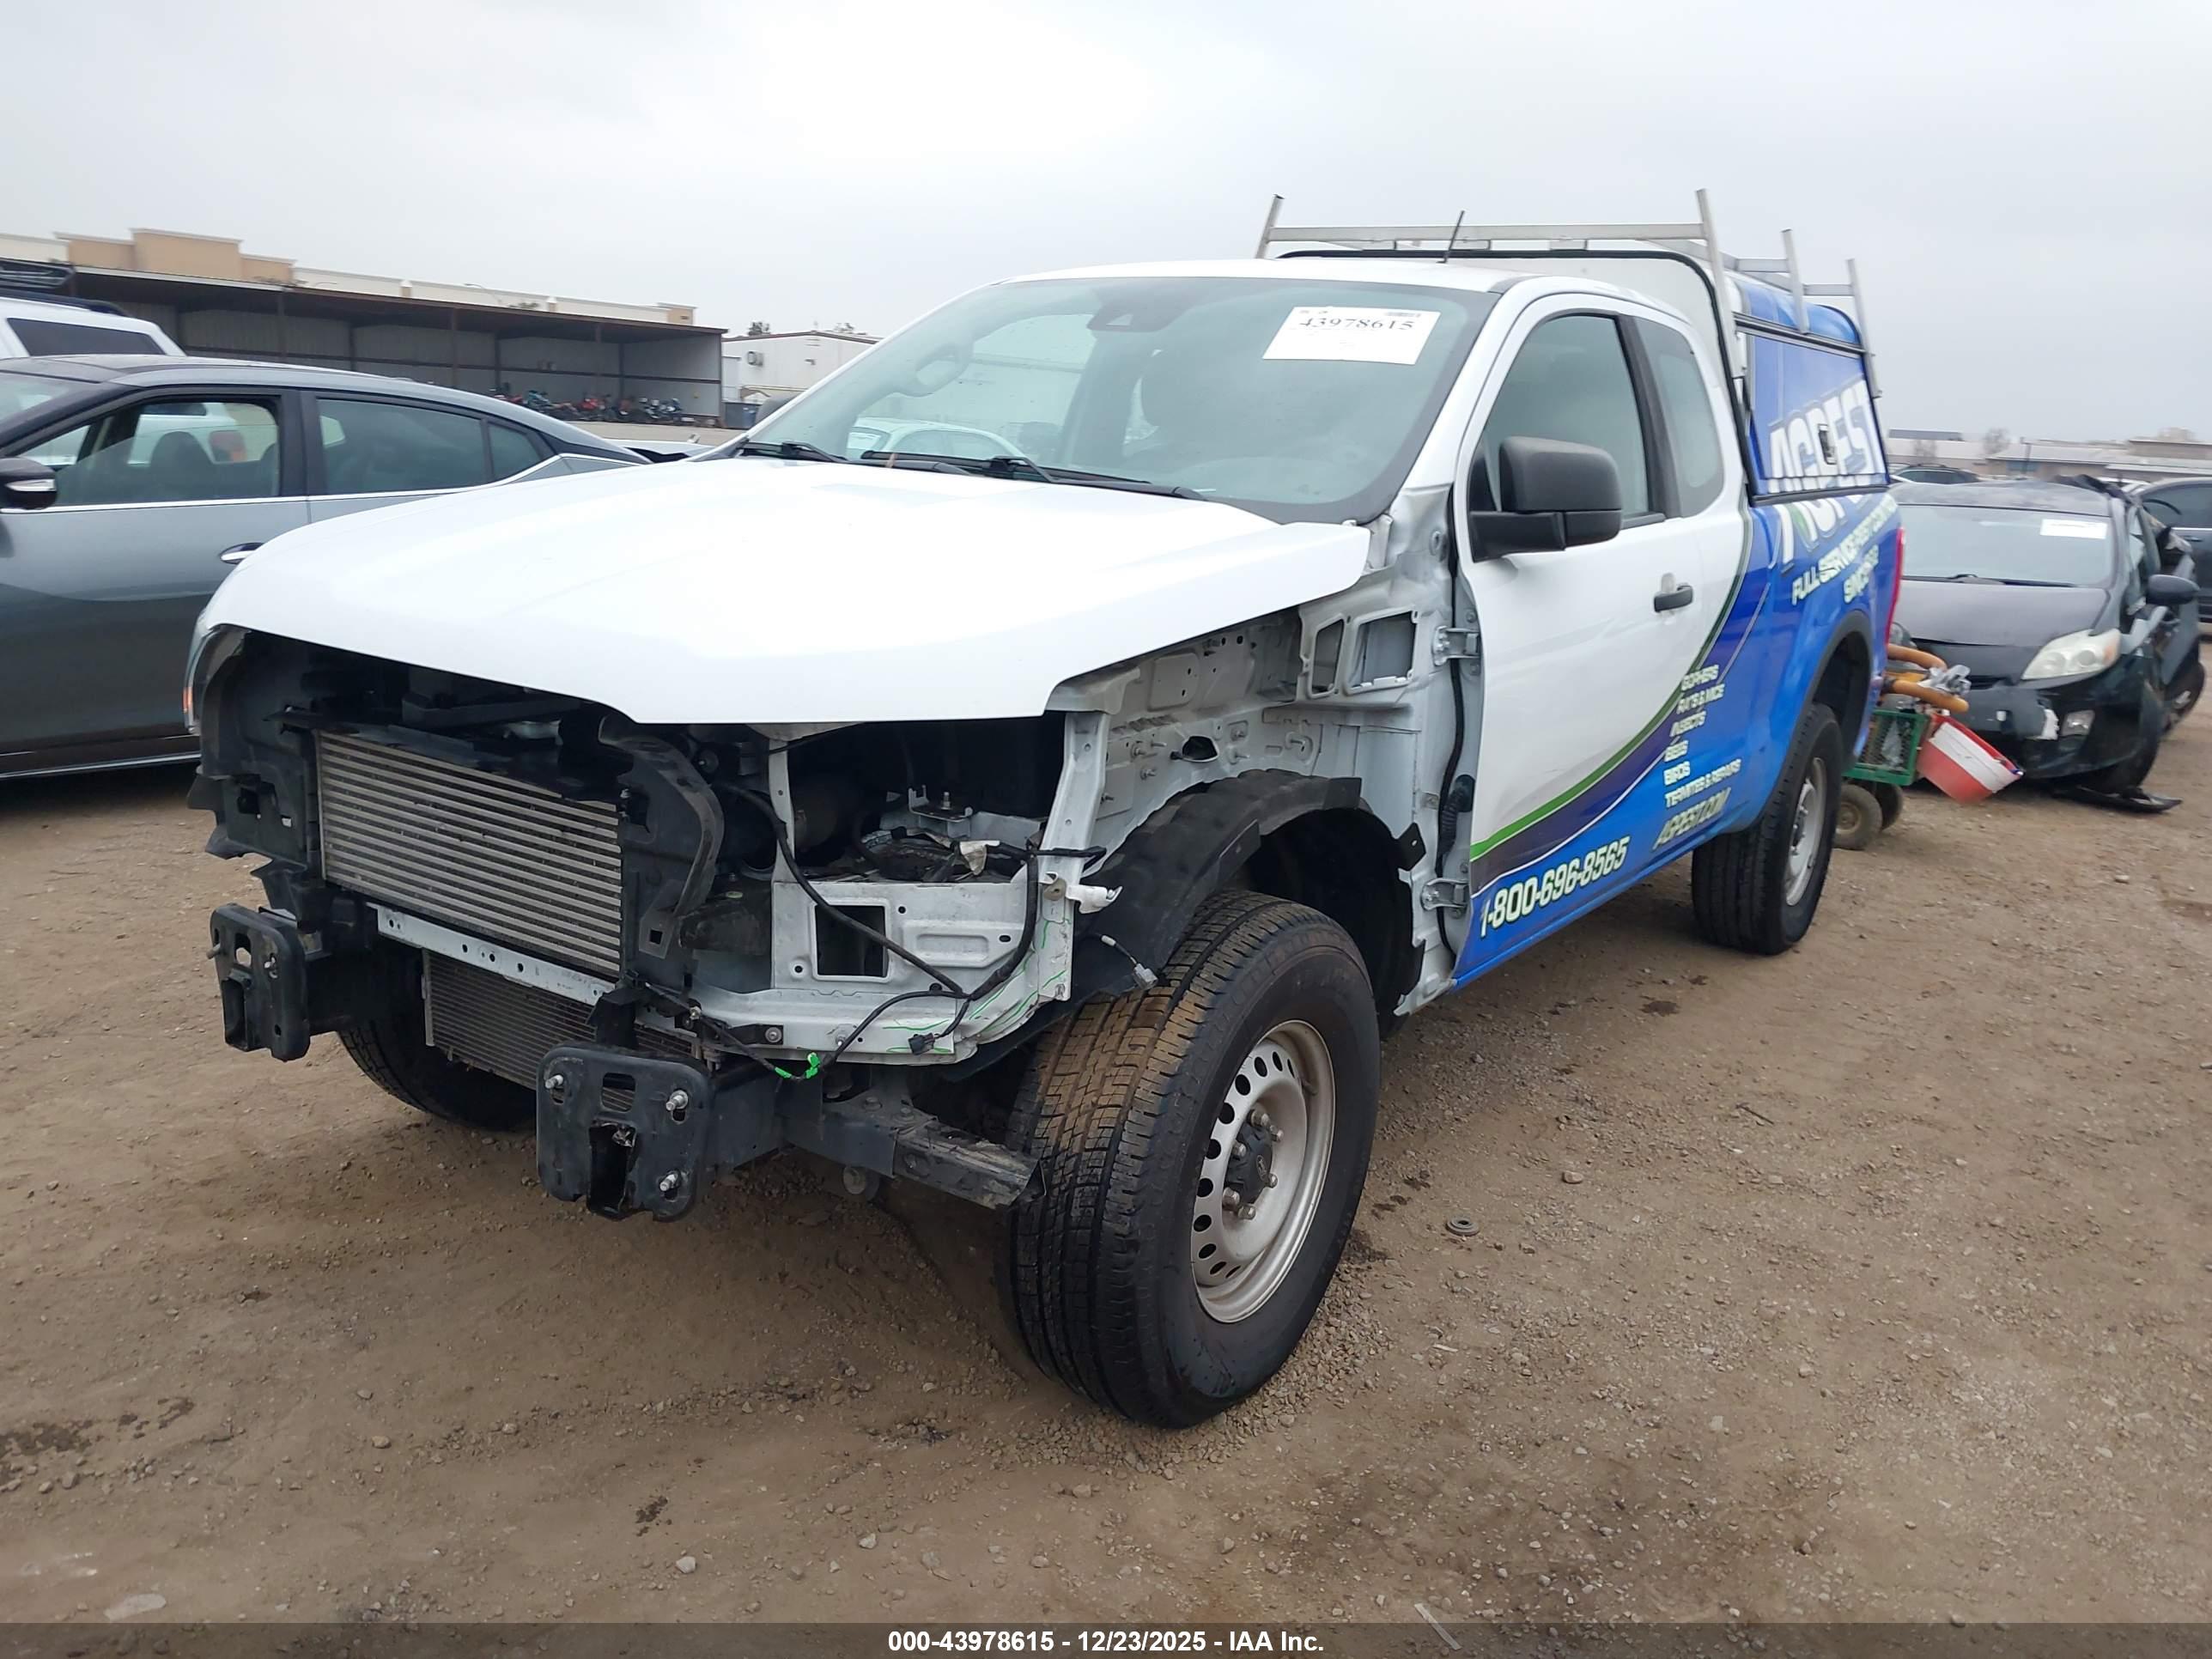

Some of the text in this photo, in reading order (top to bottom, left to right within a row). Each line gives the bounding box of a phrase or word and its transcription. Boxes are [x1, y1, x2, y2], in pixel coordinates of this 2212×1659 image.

[1298, 317, 1415, 331] 43978615
[1792, 567, 1820, 605] FULL
[1676, 693, 1699, 714] RATS
[1705, 684, 1725, 703] MICE
[1669, 710, 1706, 737] INSECTS
[1662, 760, 1691, 786] BIRDS
[1664, 775, 1705, 807] TERMITES
[1480, 836, 1630, 938] 1-800-696-8565
